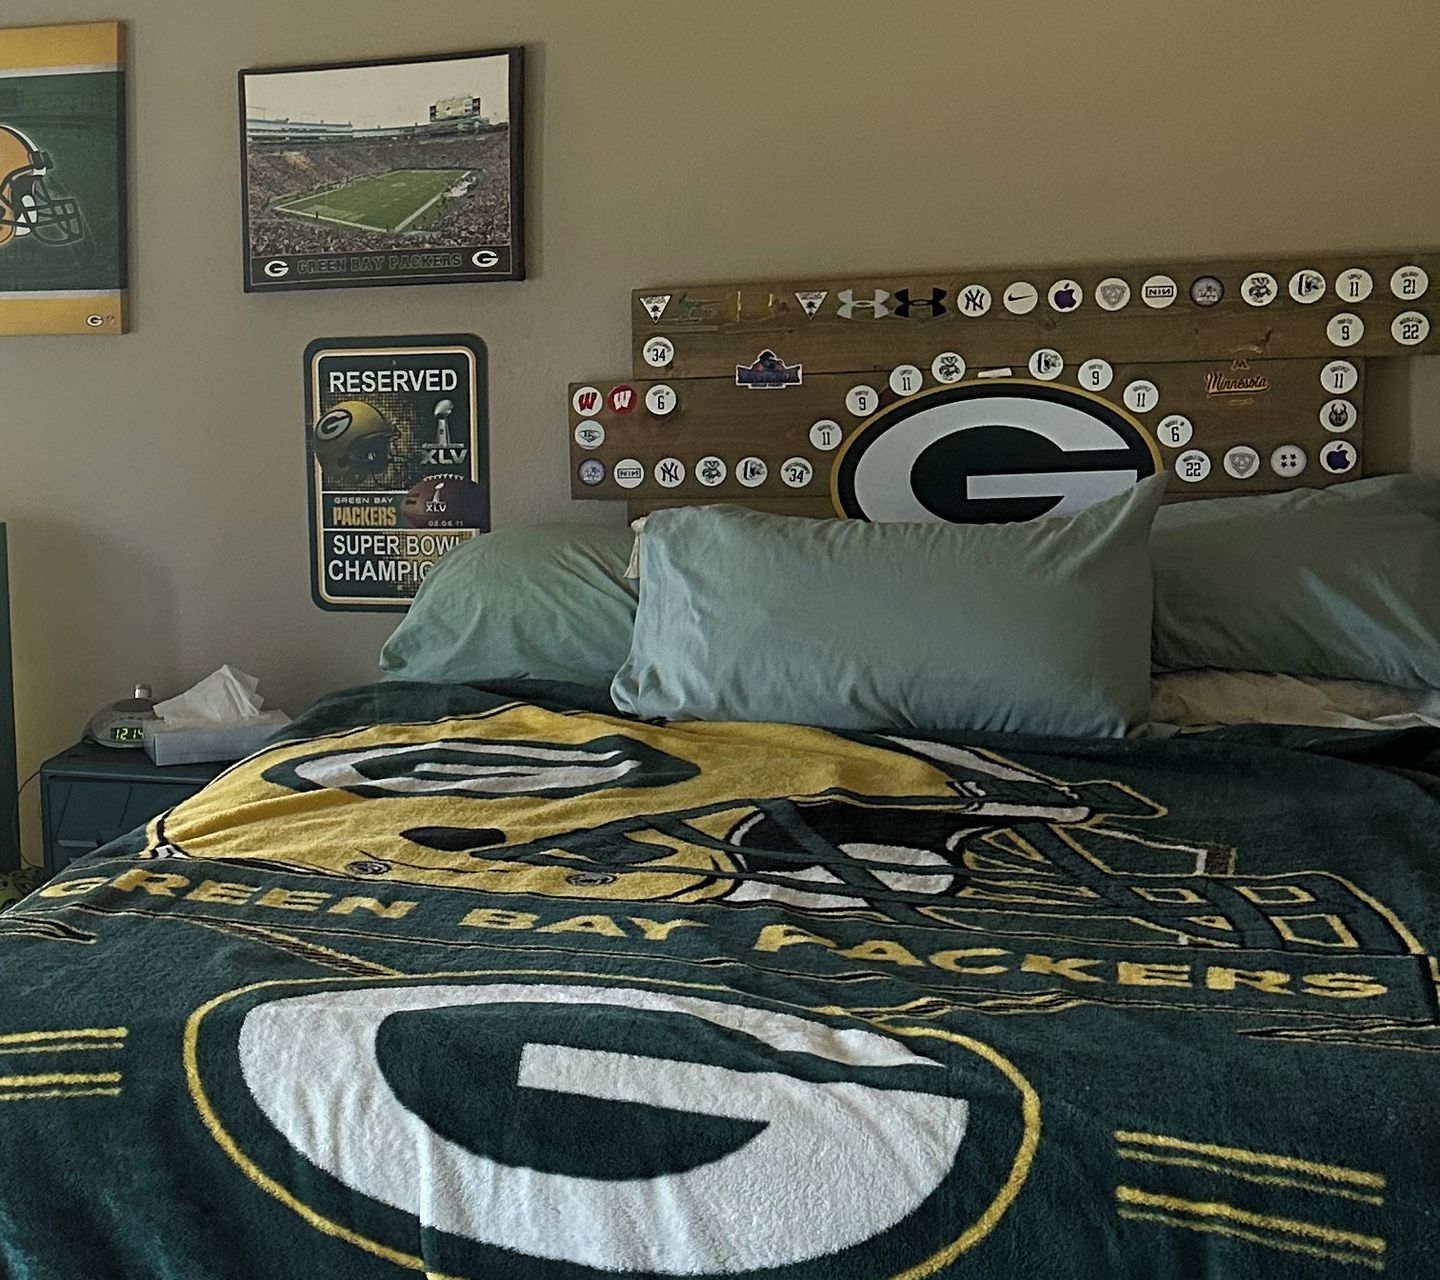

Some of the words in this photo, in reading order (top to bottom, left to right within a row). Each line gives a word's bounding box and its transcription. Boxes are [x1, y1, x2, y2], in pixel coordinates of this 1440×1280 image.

[297, 259, 349, 275] GREEN
[352, 256, 386, 273] BAY
[389, 253, 461, 269] PACKERS
[1349, 281, 1359, 296] 11
[1402, 278, 1416, 294] 21
[1342, 325, 1350, 340] 9
[1402, 324, 1419, 339] 22
[652, 348, 666, 362] 34
[329, 369, 458, 393] RESERVED
[902, 376, 911, 391] 11
[1091, 370, 1100, 385] 9
[1205, 371, 1269, 391] Minnesota
[1334, 373, 1344, 388] 11
[578, 391, 598, 412] W
[613, 390, 632, 411] W
[657, 395, 665, 410] 6
[858, 396, 866, 411] 9
[1136, 392, 1146, 407] 11
[821, 431, 831, 446] 11
[1171, 426, 1180, 442] 6
[421, 449, 468, 465] XLV
[789, 468, 804, 483] 34
[1186, 462, 1201, 477] 22
[426, 504, 447, 512] XLV
[332, 507, 397, 526] PACKERS
[333, 535, 401, 555] SUPER
[39, 868, 419, 920] GREEN
[459, 907, 710, 942] BAY
[752, 923, 1390, 1000] PACKERS
